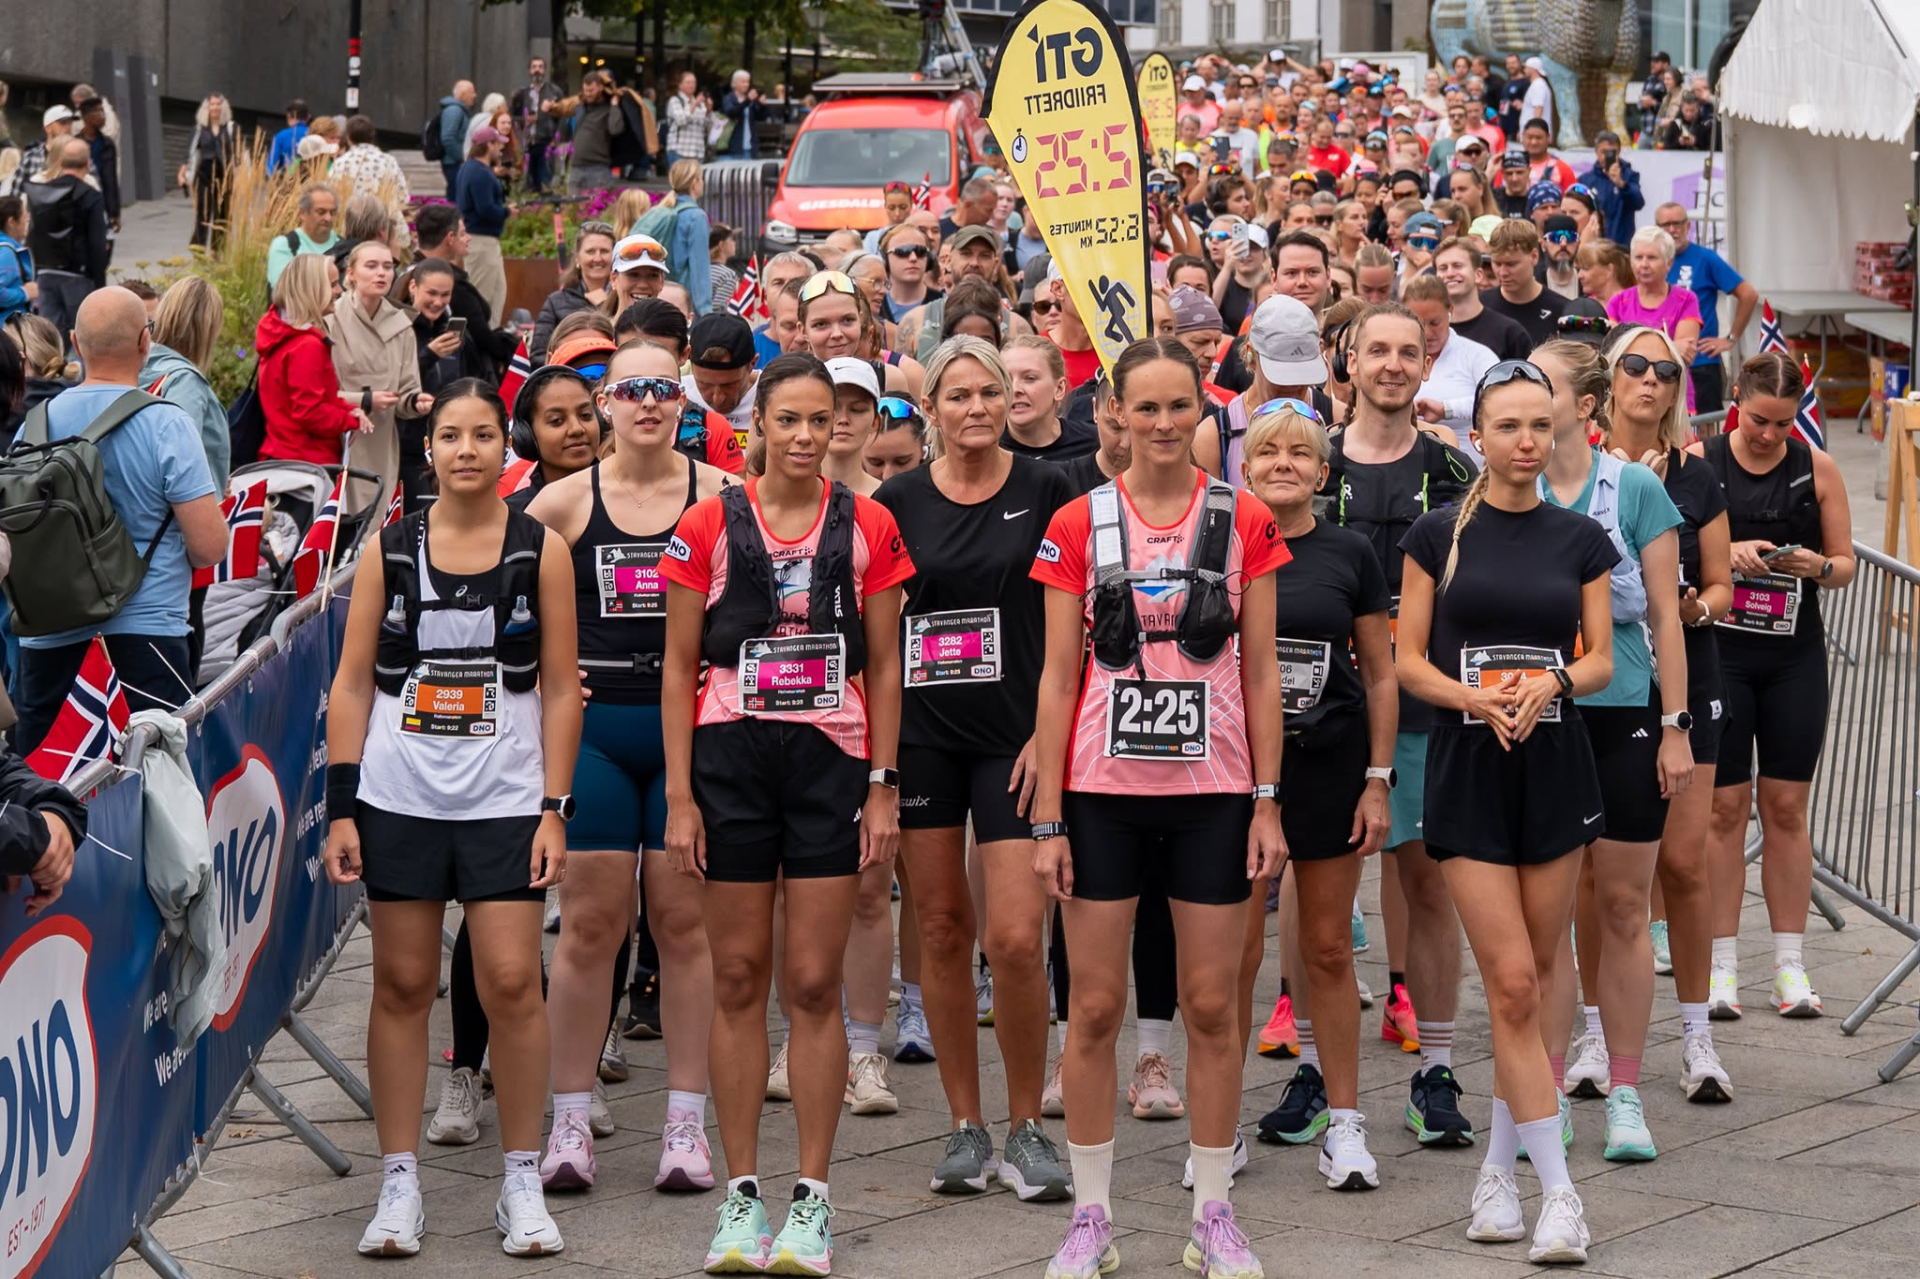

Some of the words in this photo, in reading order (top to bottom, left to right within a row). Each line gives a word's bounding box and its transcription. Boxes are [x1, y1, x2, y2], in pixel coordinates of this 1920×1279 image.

[1146, 535, 1178, 544] CRAFT
[772, 549, 803, 558] CRAFT
[635, 569, 659, 578] 3102
[635, 581, 659, 590] Anna
[1750, 592, 1770, 602] 3103
[1745, 601, 1772, 612] Solveig
[938, 635, 963, 646] 3282
[939, 647, 961, 657] Jette
[779, 663, 804, 674] 3331
[1280, 664, 1293, 673] 06
[771, 676, 812, 686] Rebekka
[1281, 677, 1295, 685] del
[436, 689, 463, 699] 2939
[433, 700, 465, 711] Valeria
[817, 697, 835, 705] DNO
[1118, 687, 1199, 735] 2:25
[473, 724, 491, 732] DNO
[900, 796, 930, 807] swix
[154, 1053, 172, 1087] We
[7, 1218, 24, 1258] EST
[30, 1195, 47, 1235] 1971
